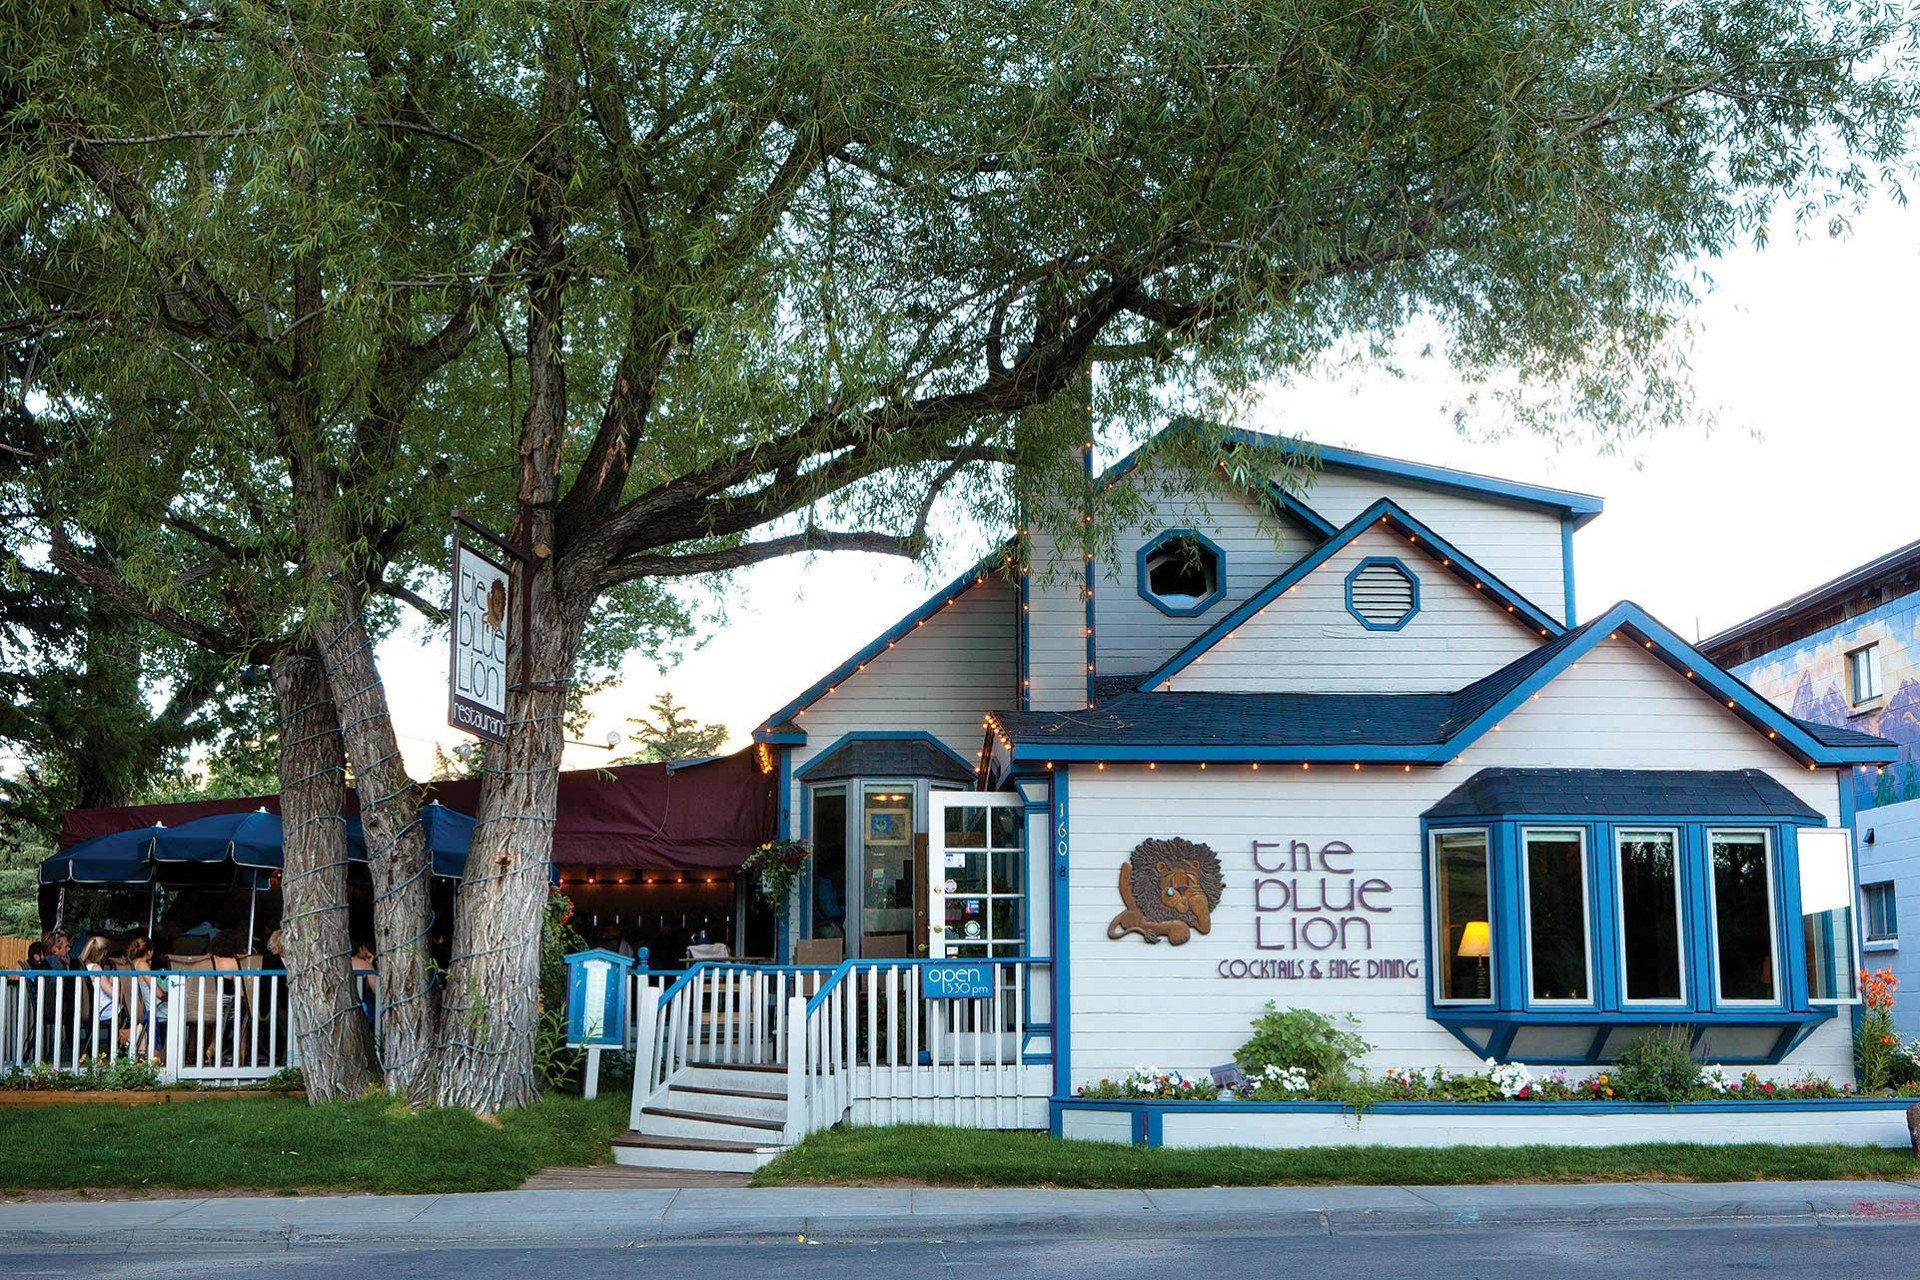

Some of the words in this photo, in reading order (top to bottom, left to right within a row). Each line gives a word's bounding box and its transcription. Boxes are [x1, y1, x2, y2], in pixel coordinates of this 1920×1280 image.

[461, 566, 486, 612] the
[458, 648, 499, 705] Lion
[453, 702, 507, 738] restaurant
[1057, 802, 1068, 856] 160
[1252, 839, 1355, 874] the
[1255, 915, 1372, 950] Lion
[928, 968, 981, 994] open
[1217, 959, 1304, 980] COCKTAILS
[1309, 959, 1323, 979] &
[1328, 959, 1361, 980] FINE
[1367, 959, 1420, 979] DINING
[972, 986, 989, 997] pm
